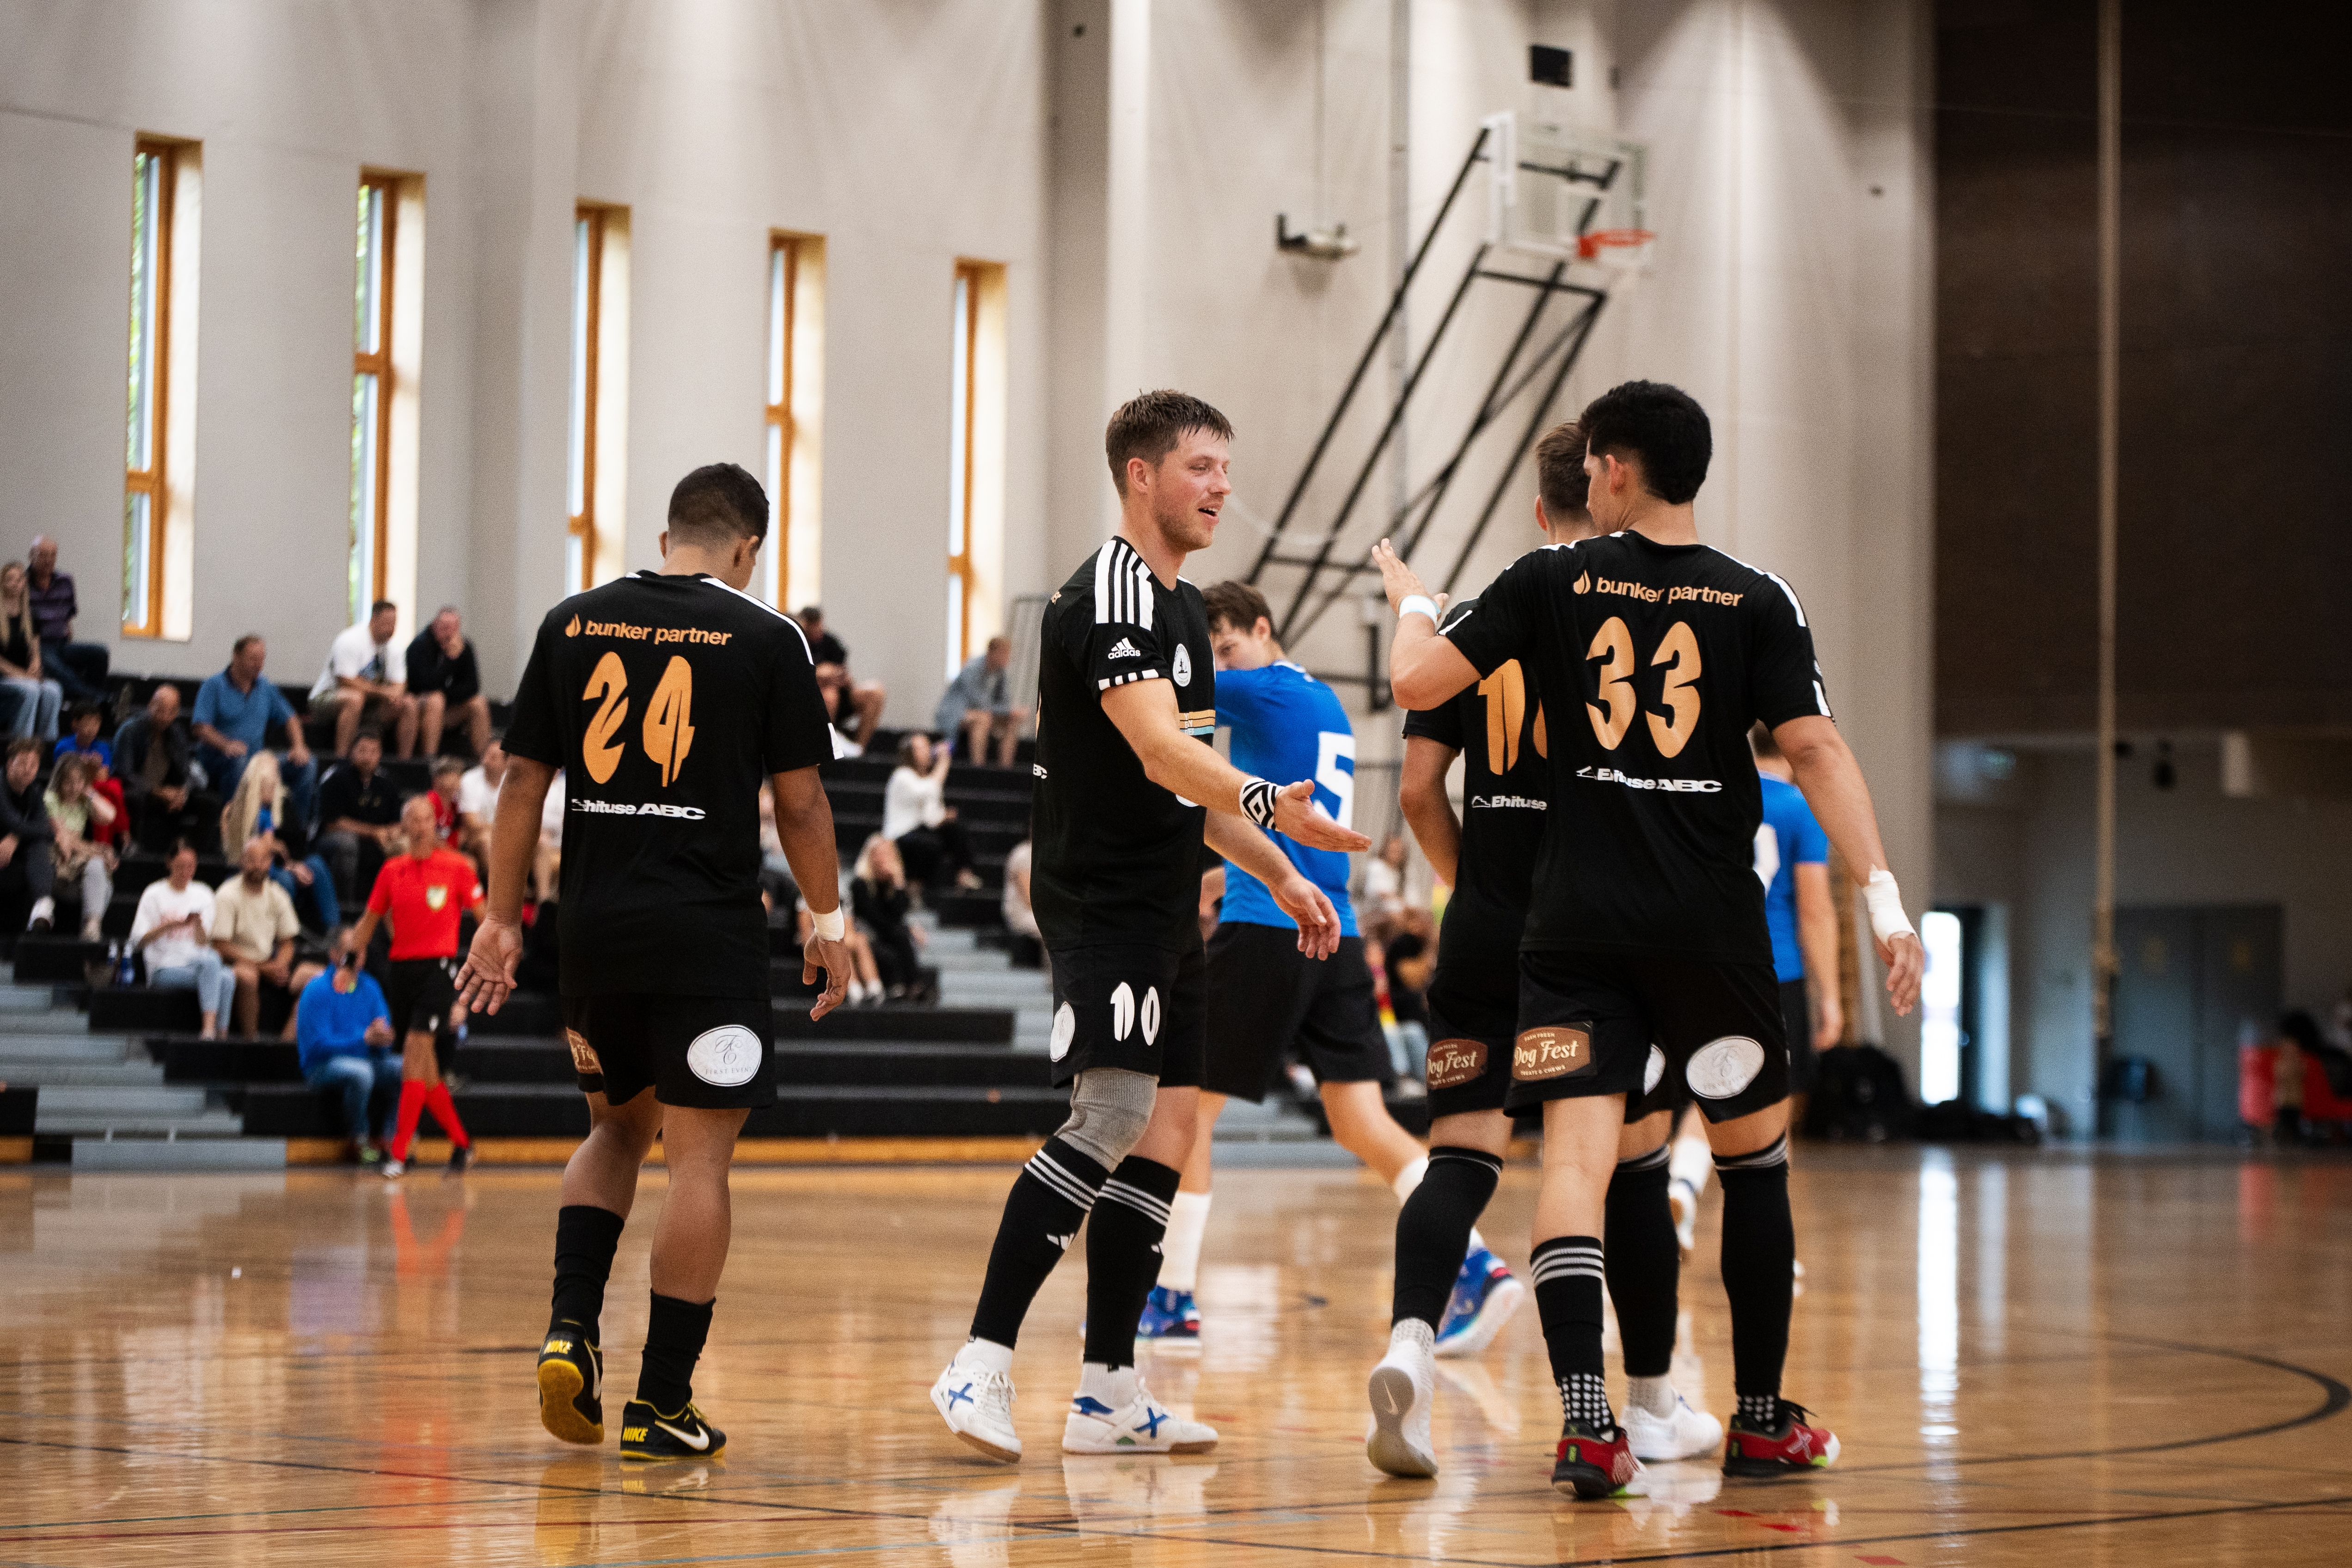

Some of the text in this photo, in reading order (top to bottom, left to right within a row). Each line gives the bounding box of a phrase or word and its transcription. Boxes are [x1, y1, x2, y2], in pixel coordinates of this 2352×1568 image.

[1596, 577, 1744, 606] bunker partner
[584, 620, 732, 645] bunker partner
[1108, 649, 1141, 660] adidas
[1586, 616, 1702, 758] 33
[582, 651, 695, 787] 24
[1033, 764, 1047, 779] BC
[1313, 731, 1355, 830] 5
[1656, 779, 1723, 792] ABC
[583, 799, 706, 820] hituse ABC
[1491, 796, 1548, 810] Ehituse
[1110, 982, 1160, 1046] 10
[1446, 1051, 1478, 1072] Fest
[1514, 1040, 1579, 1068] Dog Fest
[1544, 1065, 1566, 1074] CHEWS
[543, 1340, 573, 1355] NIKE
[622, 1426, 648, 1442] NIKE
